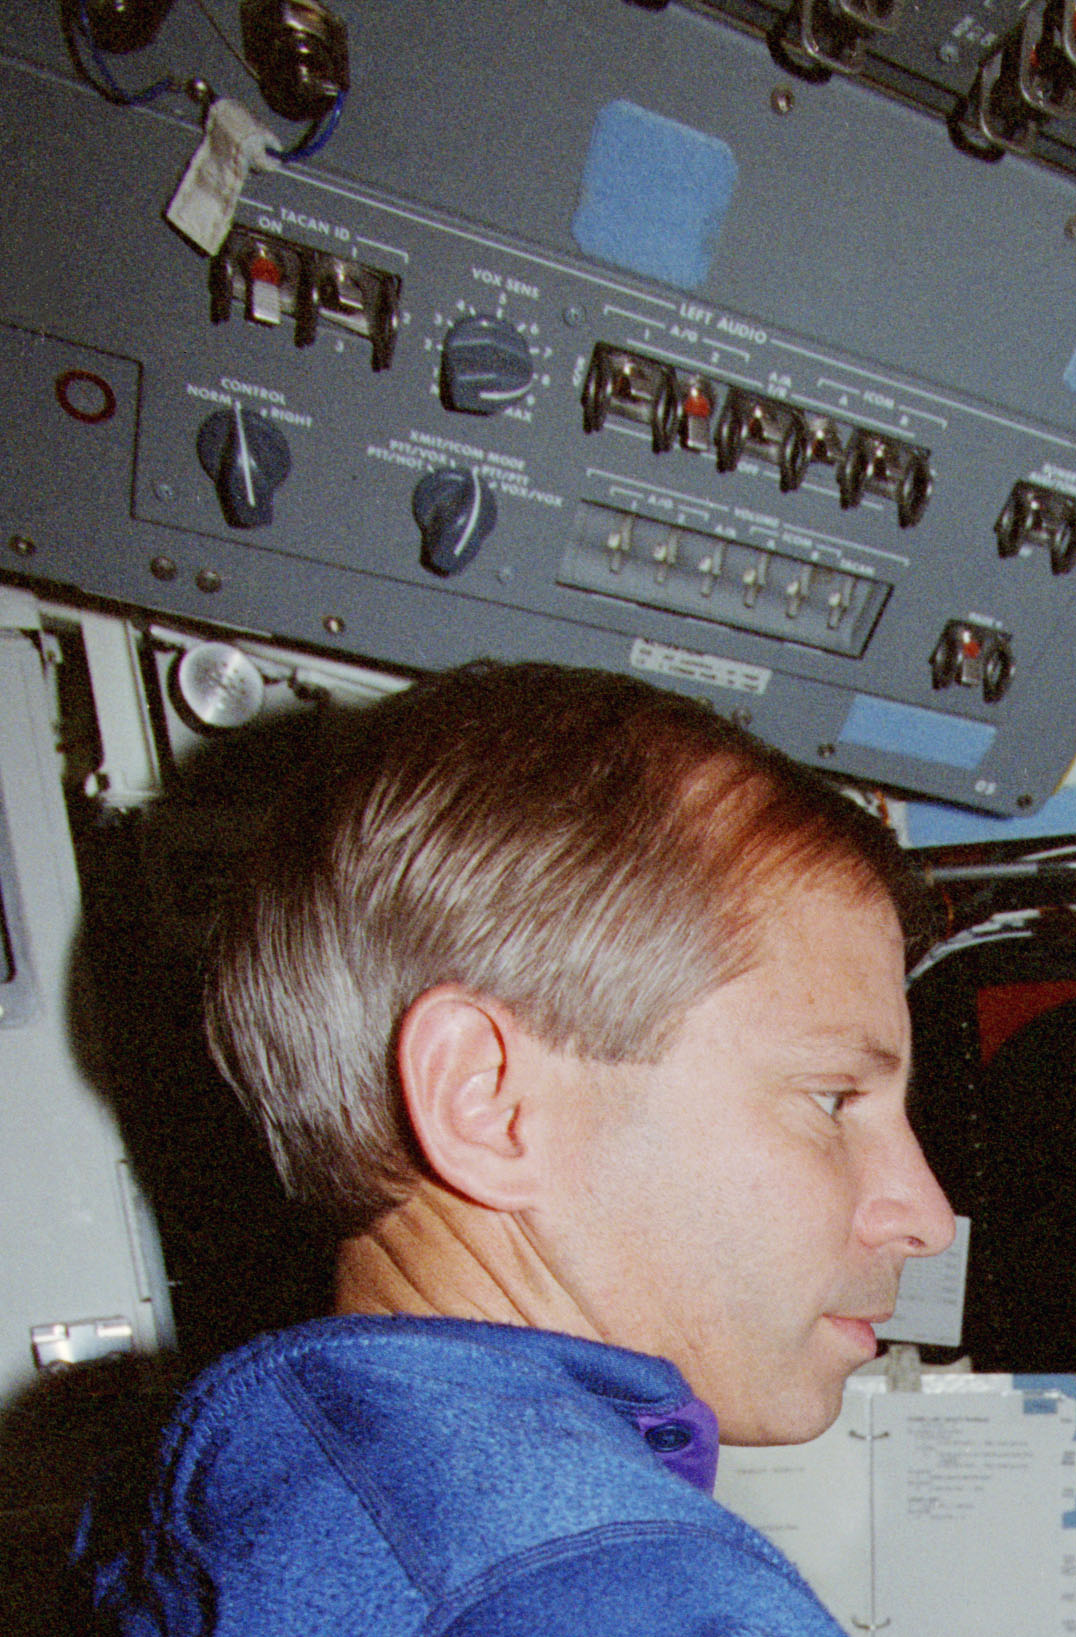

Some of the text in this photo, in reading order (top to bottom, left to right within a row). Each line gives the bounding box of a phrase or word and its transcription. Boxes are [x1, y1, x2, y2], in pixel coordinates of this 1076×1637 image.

[258, 215, 283, 234] ON
[279, 206, 350, 241] TACAN ID
[472, 268, 540, 300] VOX SENS
[680, 303, 768, 344] LEFT AUDIO
[186, 383, 232, 406] NORM
[220, 377, 287, 406] CONTROL
[863, 390, 894, 408] ICOM
[486, 451, 525, 470] MODE
